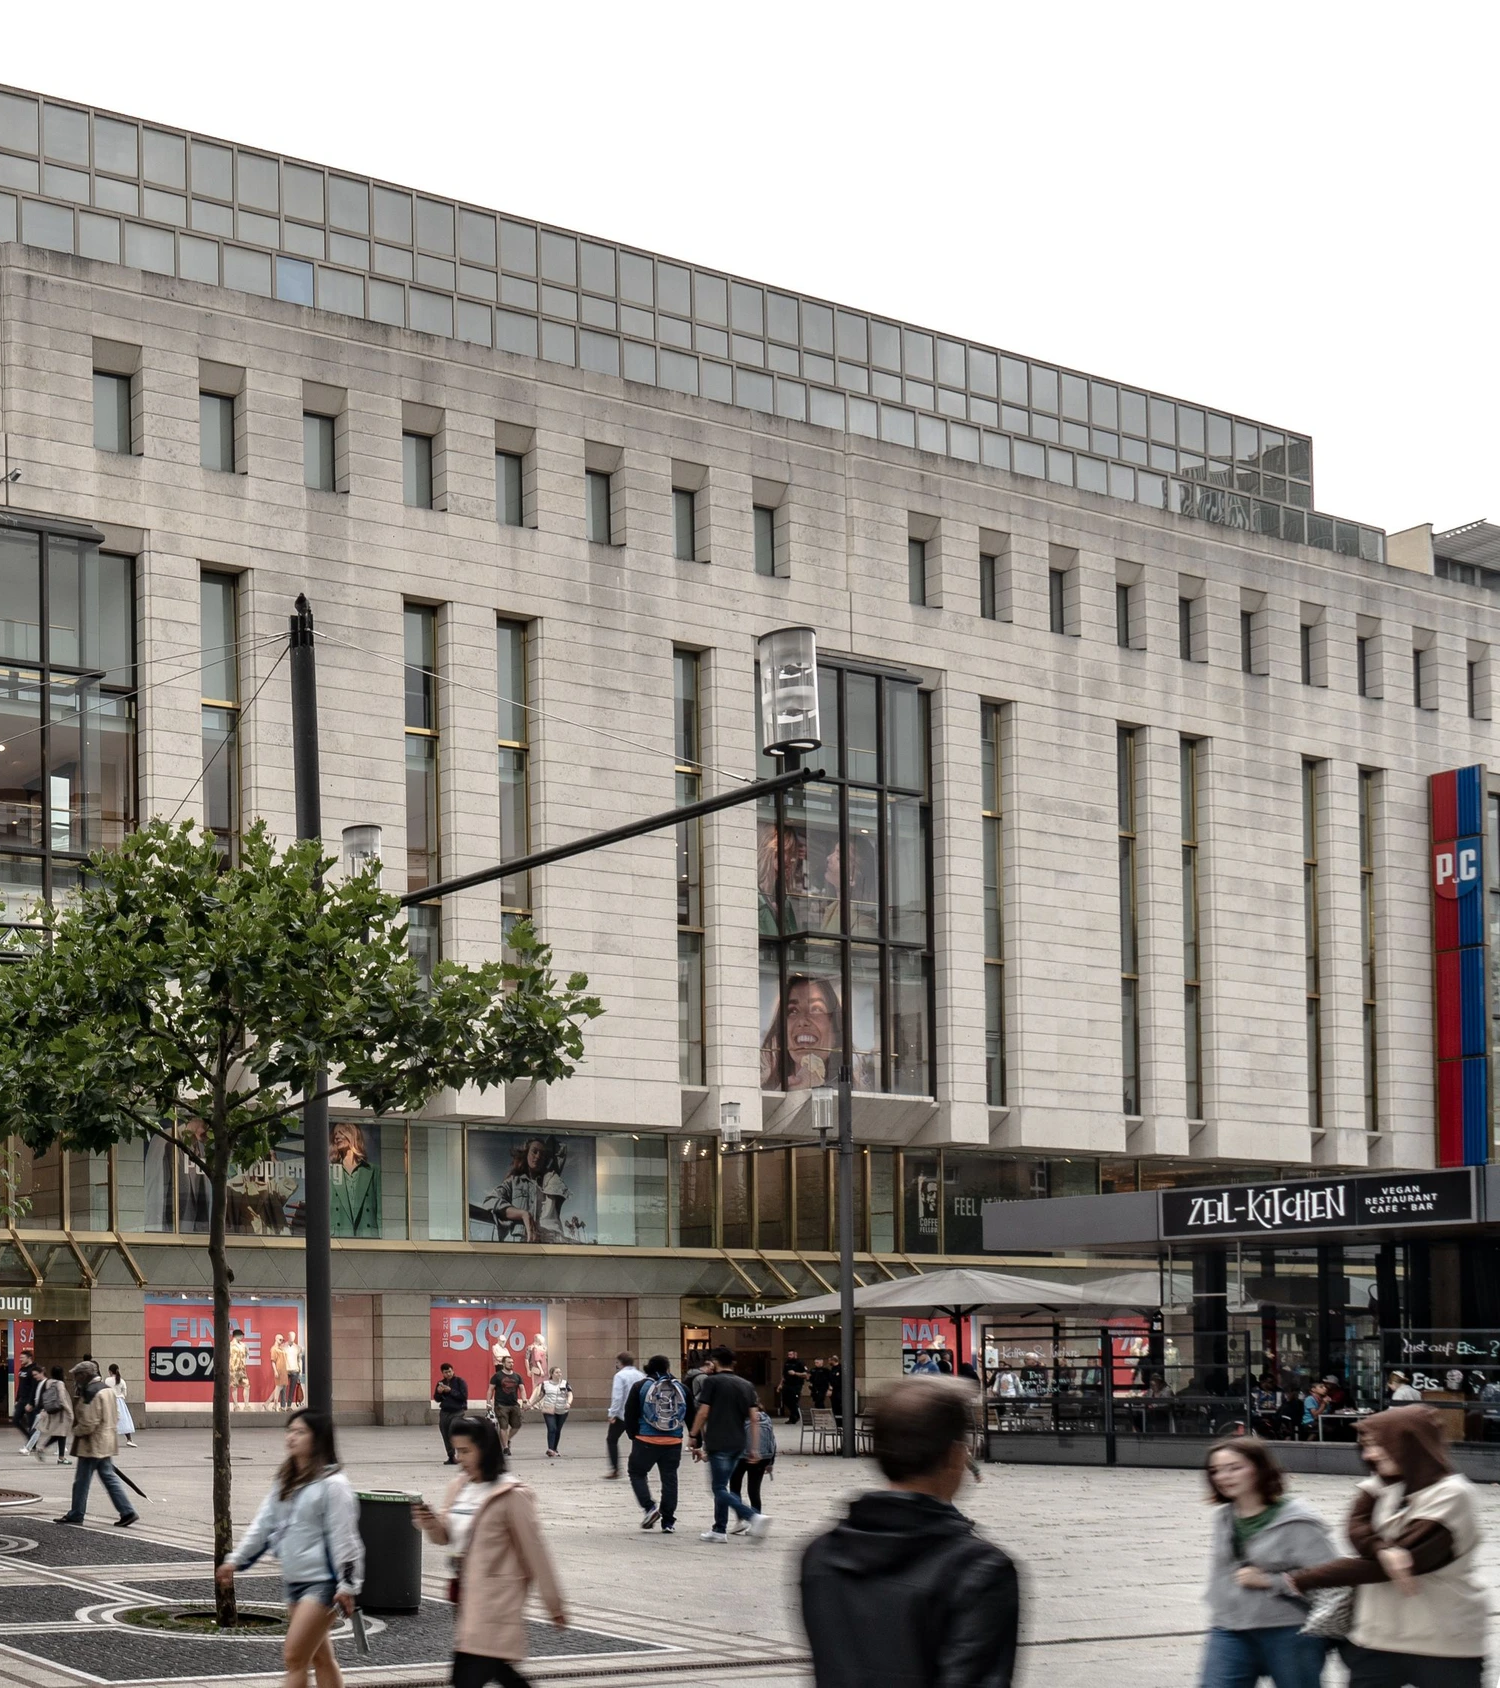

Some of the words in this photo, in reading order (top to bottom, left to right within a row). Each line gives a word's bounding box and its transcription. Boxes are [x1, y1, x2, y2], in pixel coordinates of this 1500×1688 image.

[1381, 1185, 1420, 1195] VEGAN
[1364, 1193, 1439, 1205] RESTAURANT
[954, 1197, 977, 1216] FEEL
[1369, 1204, 1398, 1214] CAFE
[1410, 1202, 1434, 1212] BAR
